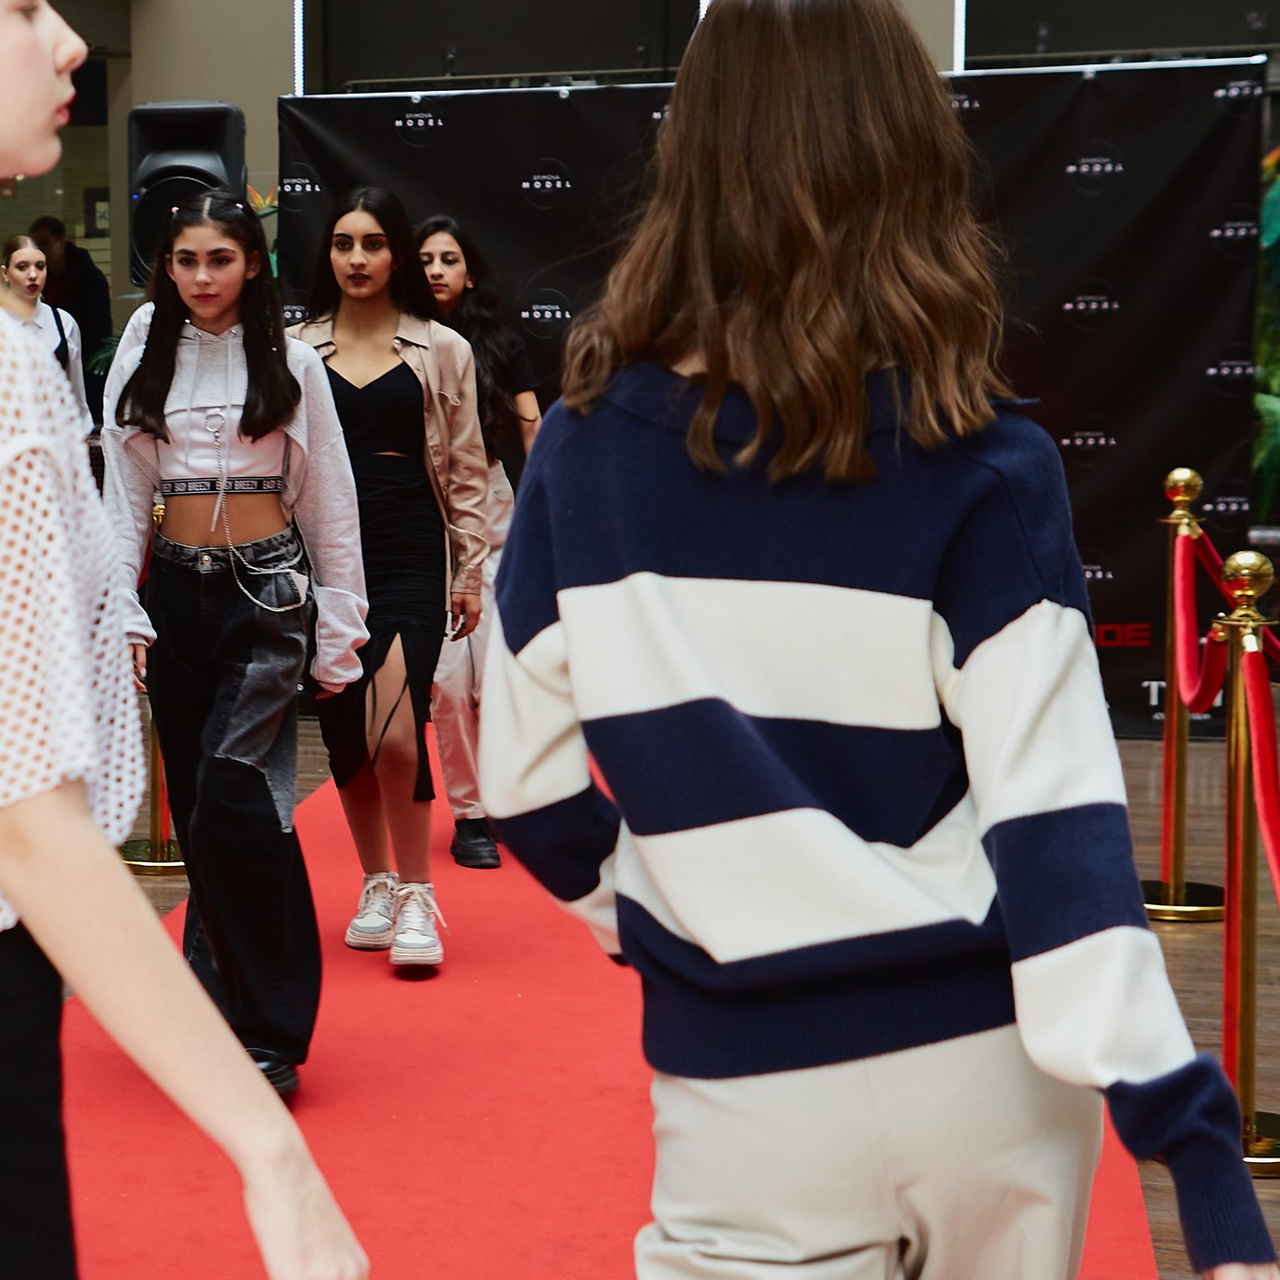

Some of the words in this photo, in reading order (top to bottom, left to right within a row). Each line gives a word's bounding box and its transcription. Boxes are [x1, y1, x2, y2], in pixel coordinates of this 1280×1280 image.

[394, 118, 444, 127] MODEL
[521, 180, 571, 189] MODEL
[520, 310, 571, 319] MODEL
